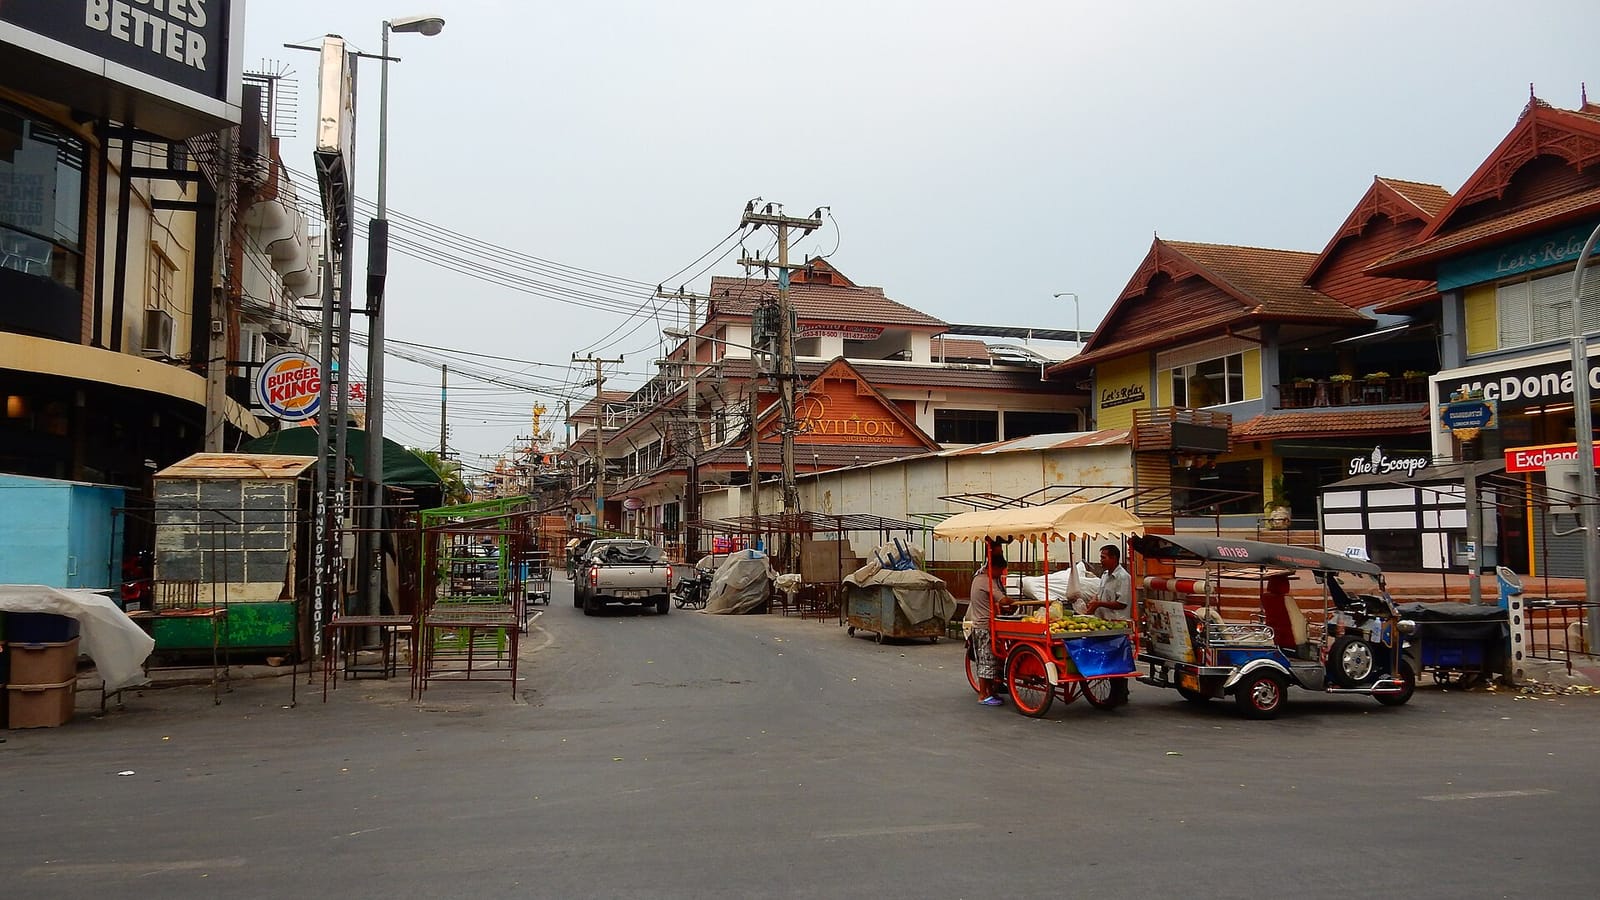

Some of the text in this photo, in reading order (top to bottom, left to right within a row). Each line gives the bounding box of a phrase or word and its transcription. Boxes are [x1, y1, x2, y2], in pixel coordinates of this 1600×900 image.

[85, 0, 206, 71] BETTER
[1542, 235, 1585, 262] Rela
[268, 367, 319, 388] BURGER
[270, 377, 320, 406] KING
[1349, 456, 1428, 477] The Scoope
